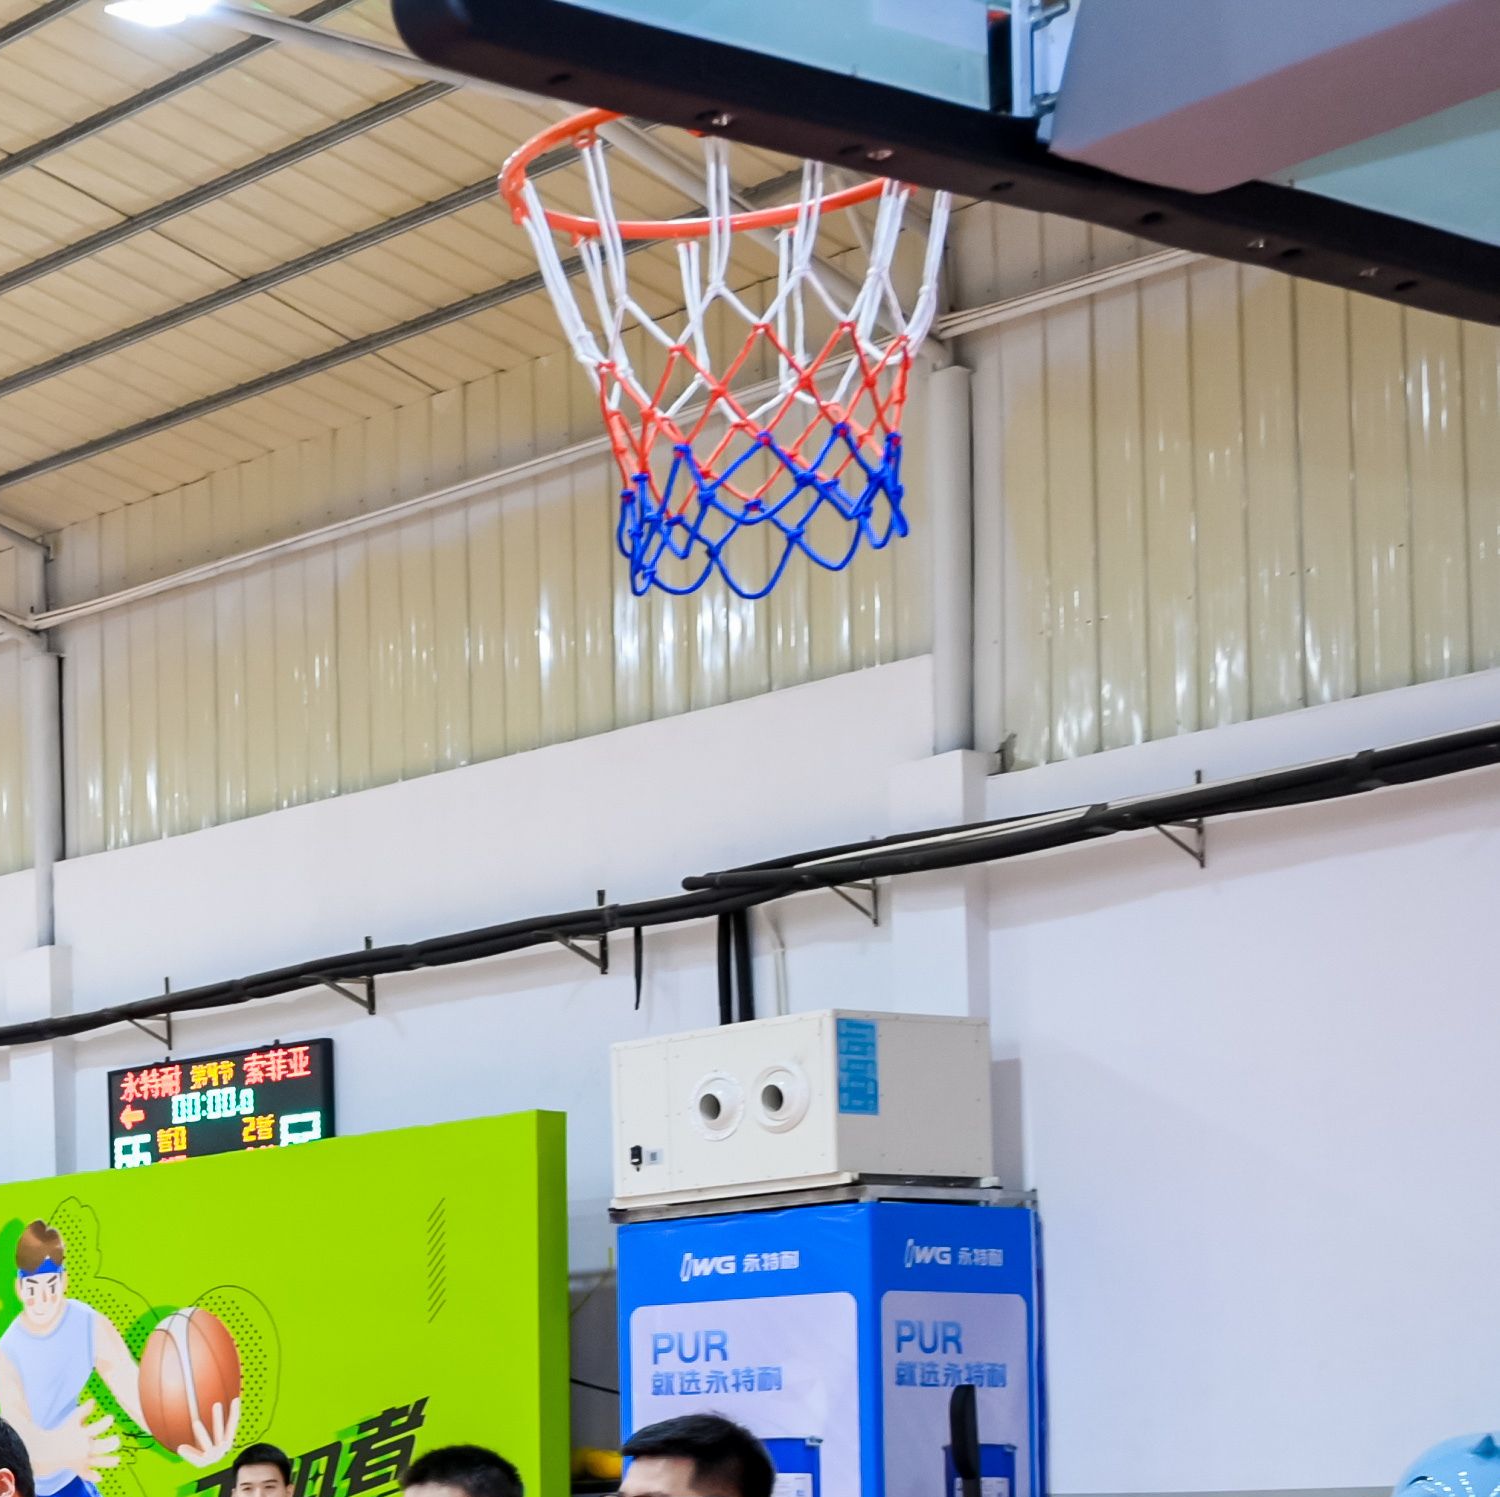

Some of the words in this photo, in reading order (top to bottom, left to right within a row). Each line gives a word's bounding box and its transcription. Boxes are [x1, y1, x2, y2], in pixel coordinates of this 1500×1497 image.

[120, 1064, 182, 1101] 永特耐
[243, 1046, 311, 1085] 索菲亚
[742, 1250, 800, 1273] 永特耐
[651, 1330, 729, 1365] PUR
[895, 1320, 963, 1354] PUR
[651, 1366, 783, 1396] 就选永特耐
